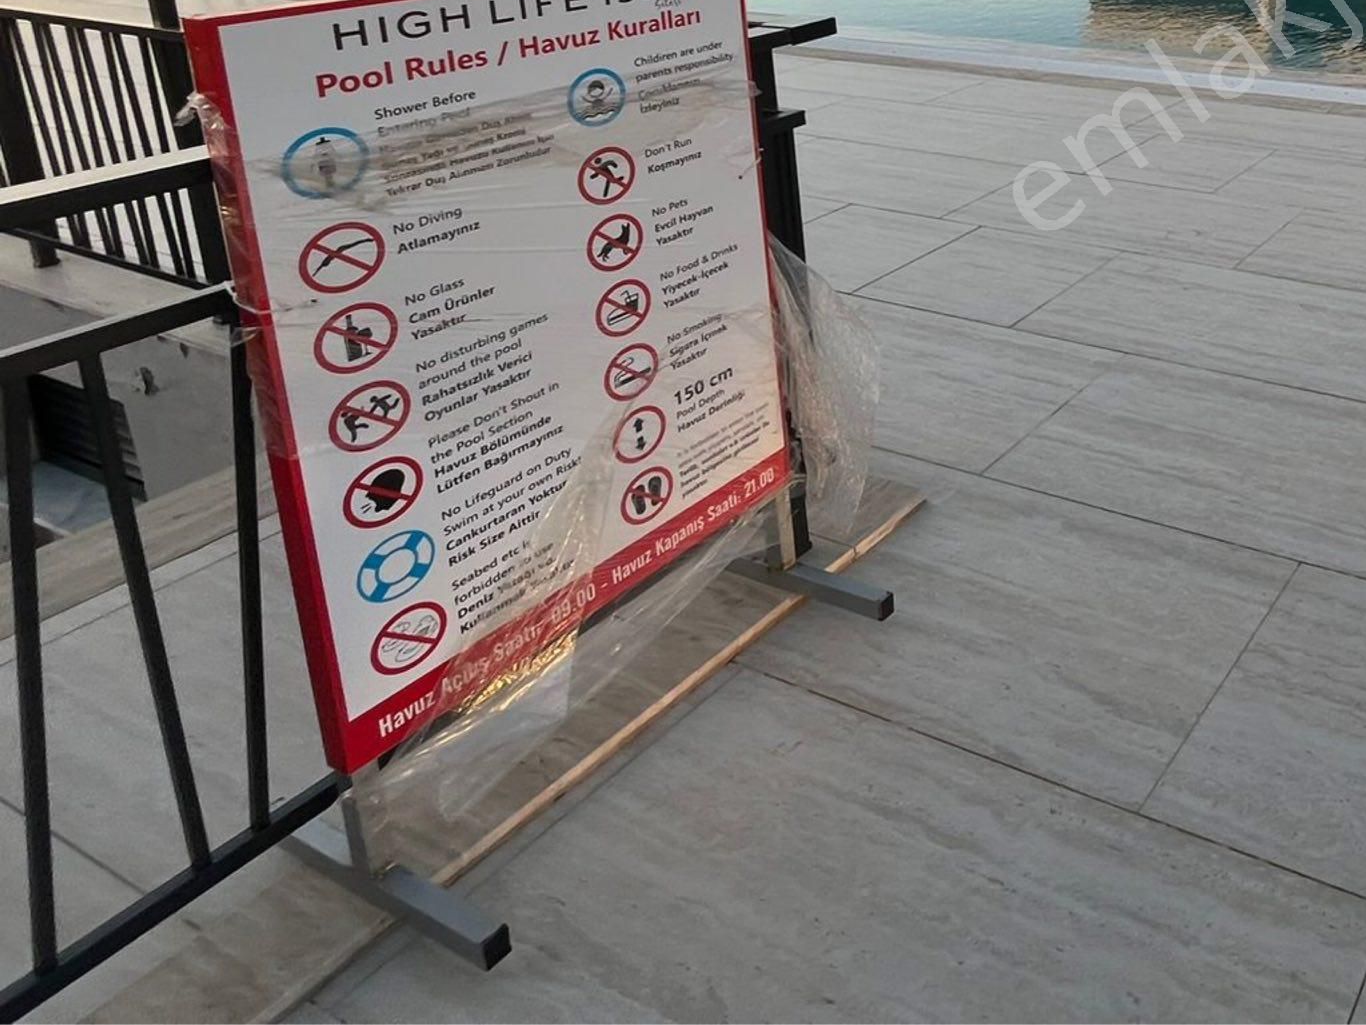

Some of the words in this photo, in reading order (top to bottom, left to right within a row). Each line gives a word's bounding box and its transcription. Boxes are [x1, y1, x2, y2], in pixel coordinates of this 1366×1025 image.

[332, 3, 471, 50] HIGH
[315, 61, 393, 98] Pool
[404, 48, 488, 80] Rules
[496, 40, 509, 65] /
[518, 28, 600, 58] Havuz
[607, 9, 700, 40] Kuralları
[679, 47, 694, 57] are
[696, 41, 722, 53] under
[635, 67, 671, 83] parents
[373, 100, 427, 120] Shower
[431, 90, 475, 107] Before
[647, 150, 701, 174] Koşmayınız
[673, 137, 692, 149] Run
[392, 221, 414, 235] No
[418, 207, 462, 228] Diving
[651, 206, 666, 217] No
[668, 198, 688, 210] Pets
[654, 217, 676, 232] Evcil
[678, 205, 713, 224] Hayvan
[397, 220, 480, 255] Atlamayınız
[656, 226, 693, 245] Yasaktır
[659, 269, 674, 281] No
[676, 258, 699, 274] Food
[701, 255, 708, 264] &
[710, 243, 737, 260] Drinks
[404, 291, 426, 306] No
[429, 277, 464, 296] Glass
[408, 306, 440, 324] Cam
[443, 285, 494, 311] Ürünler
[411, 313, 466, 340] Yasaktır
[415, 358, 436, 373] No
[439, 330, 506, 363] disturbing
[509, 313, 548, 337] games
[667, 332, 681, 345] No
[418, 361, 466, 389] around
[469, 352, 491, 367] the
[494, 337, 522, 360] pool
[421, 367, 494, 406] Rahatsızlık
[497, 350, 532, 372] Verici
[423, 391, 478, 422] Oyunlar
[481, 368, 531, 396] Yasaktır
[674, 379, 704, 405] 150
[709, 366, 732, 387] cm
[427, 422, 470, 448] Please
[473, 404, 507, 427] Don't
[509, 387, 545, 410] Shout
[548, 381, 559, 392] in
[430, 447, 452, 464] the
[456, 430, 484, 452] Pool
[487, 409, 533, 436] Section
[433, 451, 477, 478] Havuz
[480, 415, 551, 455] Bölümünde
[436, 466, 480, 494] Lütfen
[483, 424, 563, 470] Bağırmayınız
[440, 504, 461, 521] No
[464, 470, 522, 509] Lifeguard
[525, 462, 541, 476] on
[544, 447, 571, 467] Duty
[443, 512, 478, 536] Swim
[481, 502, 494, 516] at
[496, 486, 525, 510] your
[527, 472, 552, 491] own
[445, 502, 525, 551] Cankurtaran
[528, 479, 567, 506] Yoktur
[448, 545, 476, 567] Risk
[478, 529, 505, 550] Size
[508, 509, 540, 533] Aittir
[451, 556, 497, 591] Seabed
[500, 546, 519, 562] etc
[454, 564, 515, 605] forbidden
[378, 691, 435, 738] Havuz
[612, 550, 652, 584] Havuz
[655, 516, 705, 557] Kapanış
[743, 468, 775, 498] 21.00
[457, 592, 494, 619] Deniz
